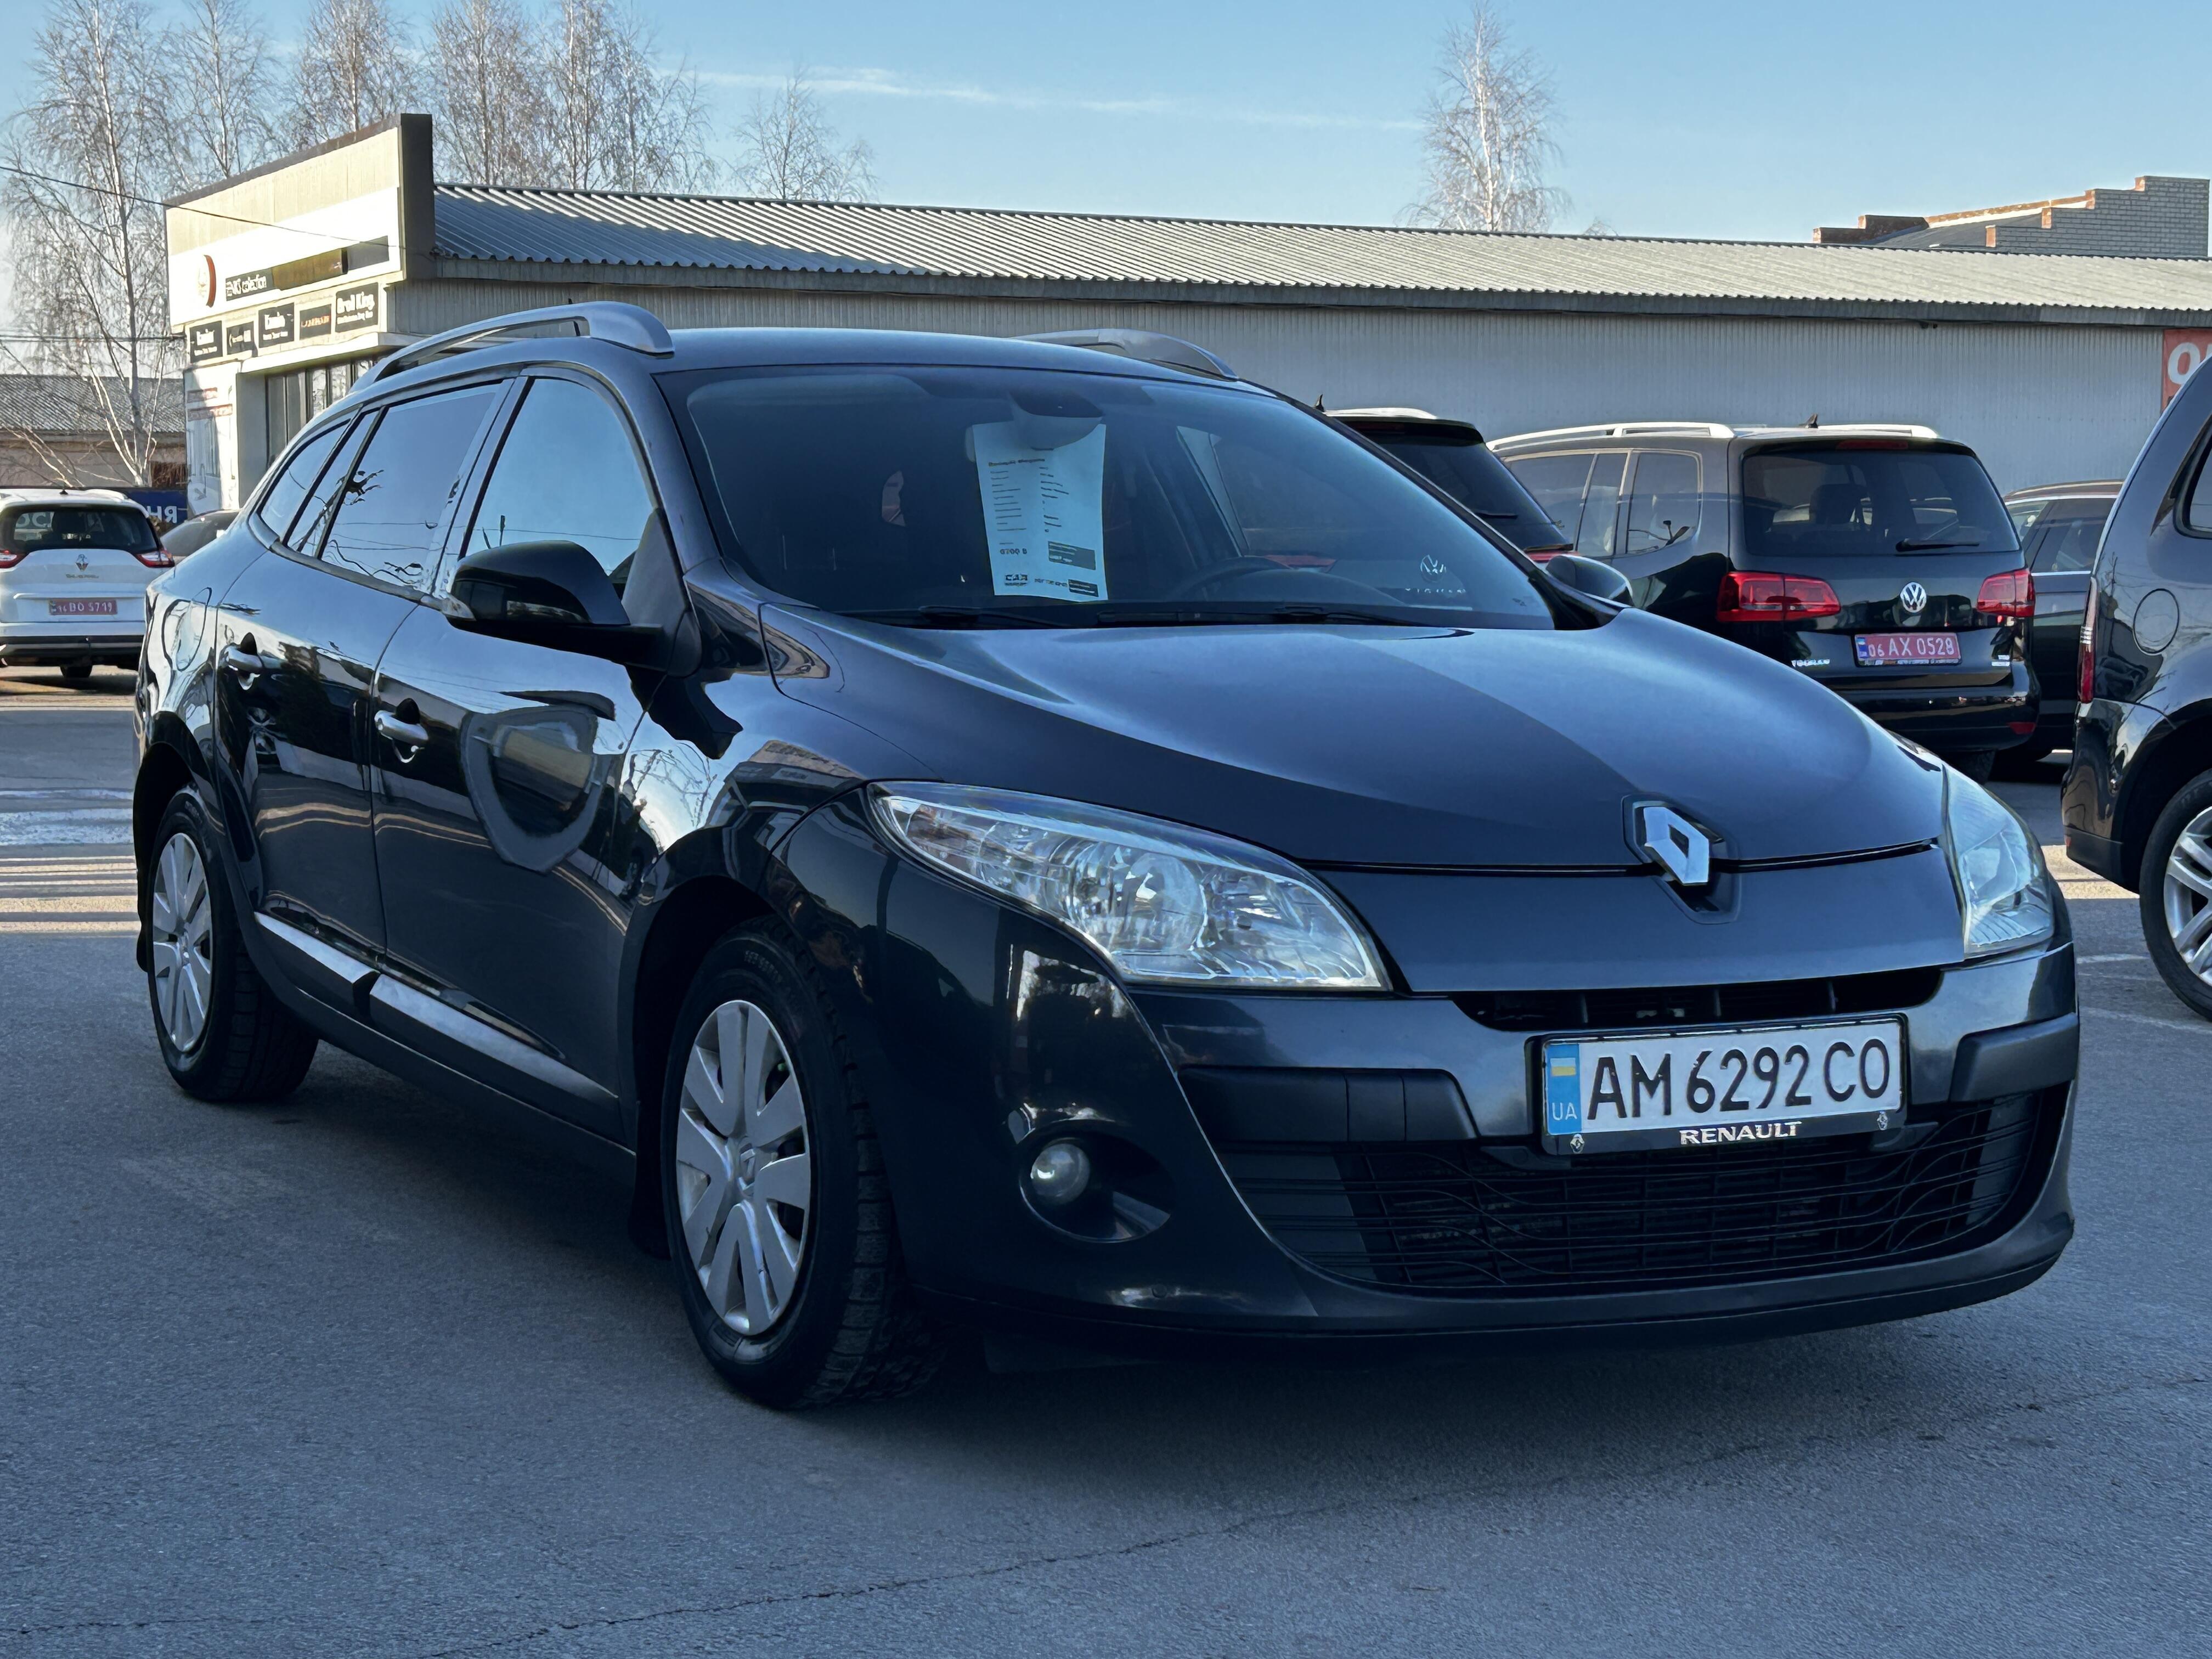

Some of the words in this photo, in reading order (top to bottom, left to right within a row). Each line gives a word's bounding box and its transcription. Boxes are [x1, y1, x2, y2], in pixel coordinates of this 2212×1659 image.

[1868, 644, 1885, 657] 06
[1889, 637, 1912, 656] AX
[1916, 637, 1954, 656] 0528
[1587, 1053, 1672, 1120] AM
[1686, 1044, 1812, 1113] 6292
[1824, 1038, 1891, 1102] CO
[1551, 1102, 1578, 1121] UA
[1679, 1121, 1802, 1146] RENAULT
